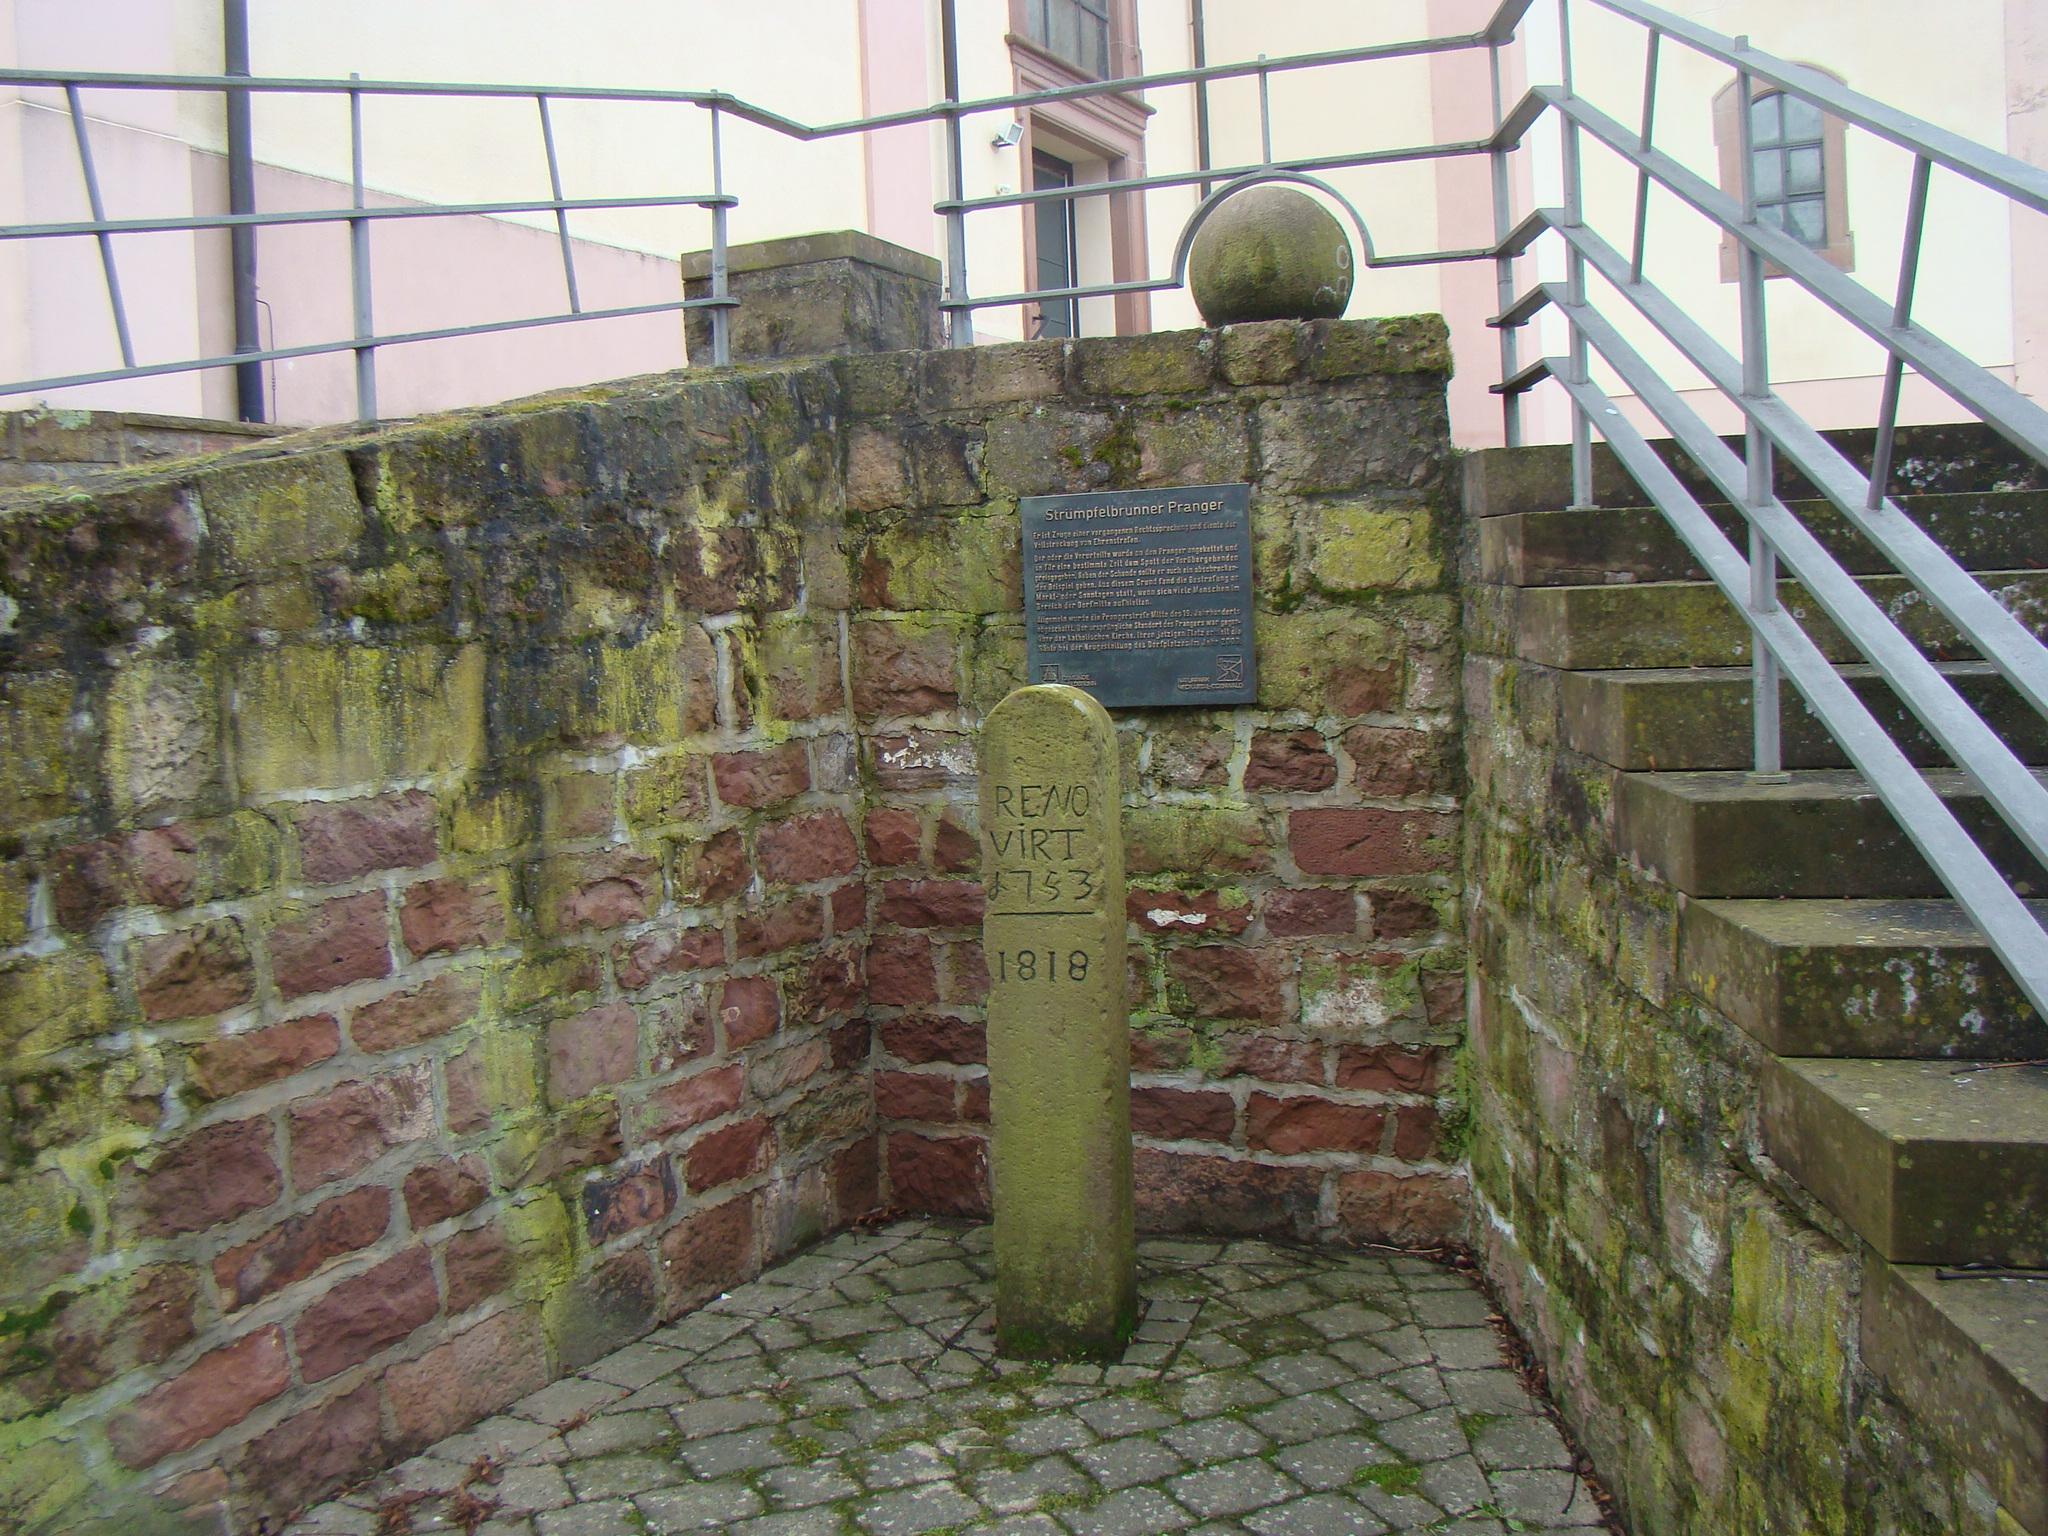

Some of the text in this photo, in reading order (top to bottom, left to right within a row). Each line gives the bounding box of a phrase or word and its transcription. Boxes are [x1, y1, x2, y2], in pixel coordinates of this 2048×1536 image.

[1045, 501, 1224, 521] Strümpfelbrunner Pranger
[995, 785, 1090, 818] RENO
[998, 950, 1089, 983] 1818
